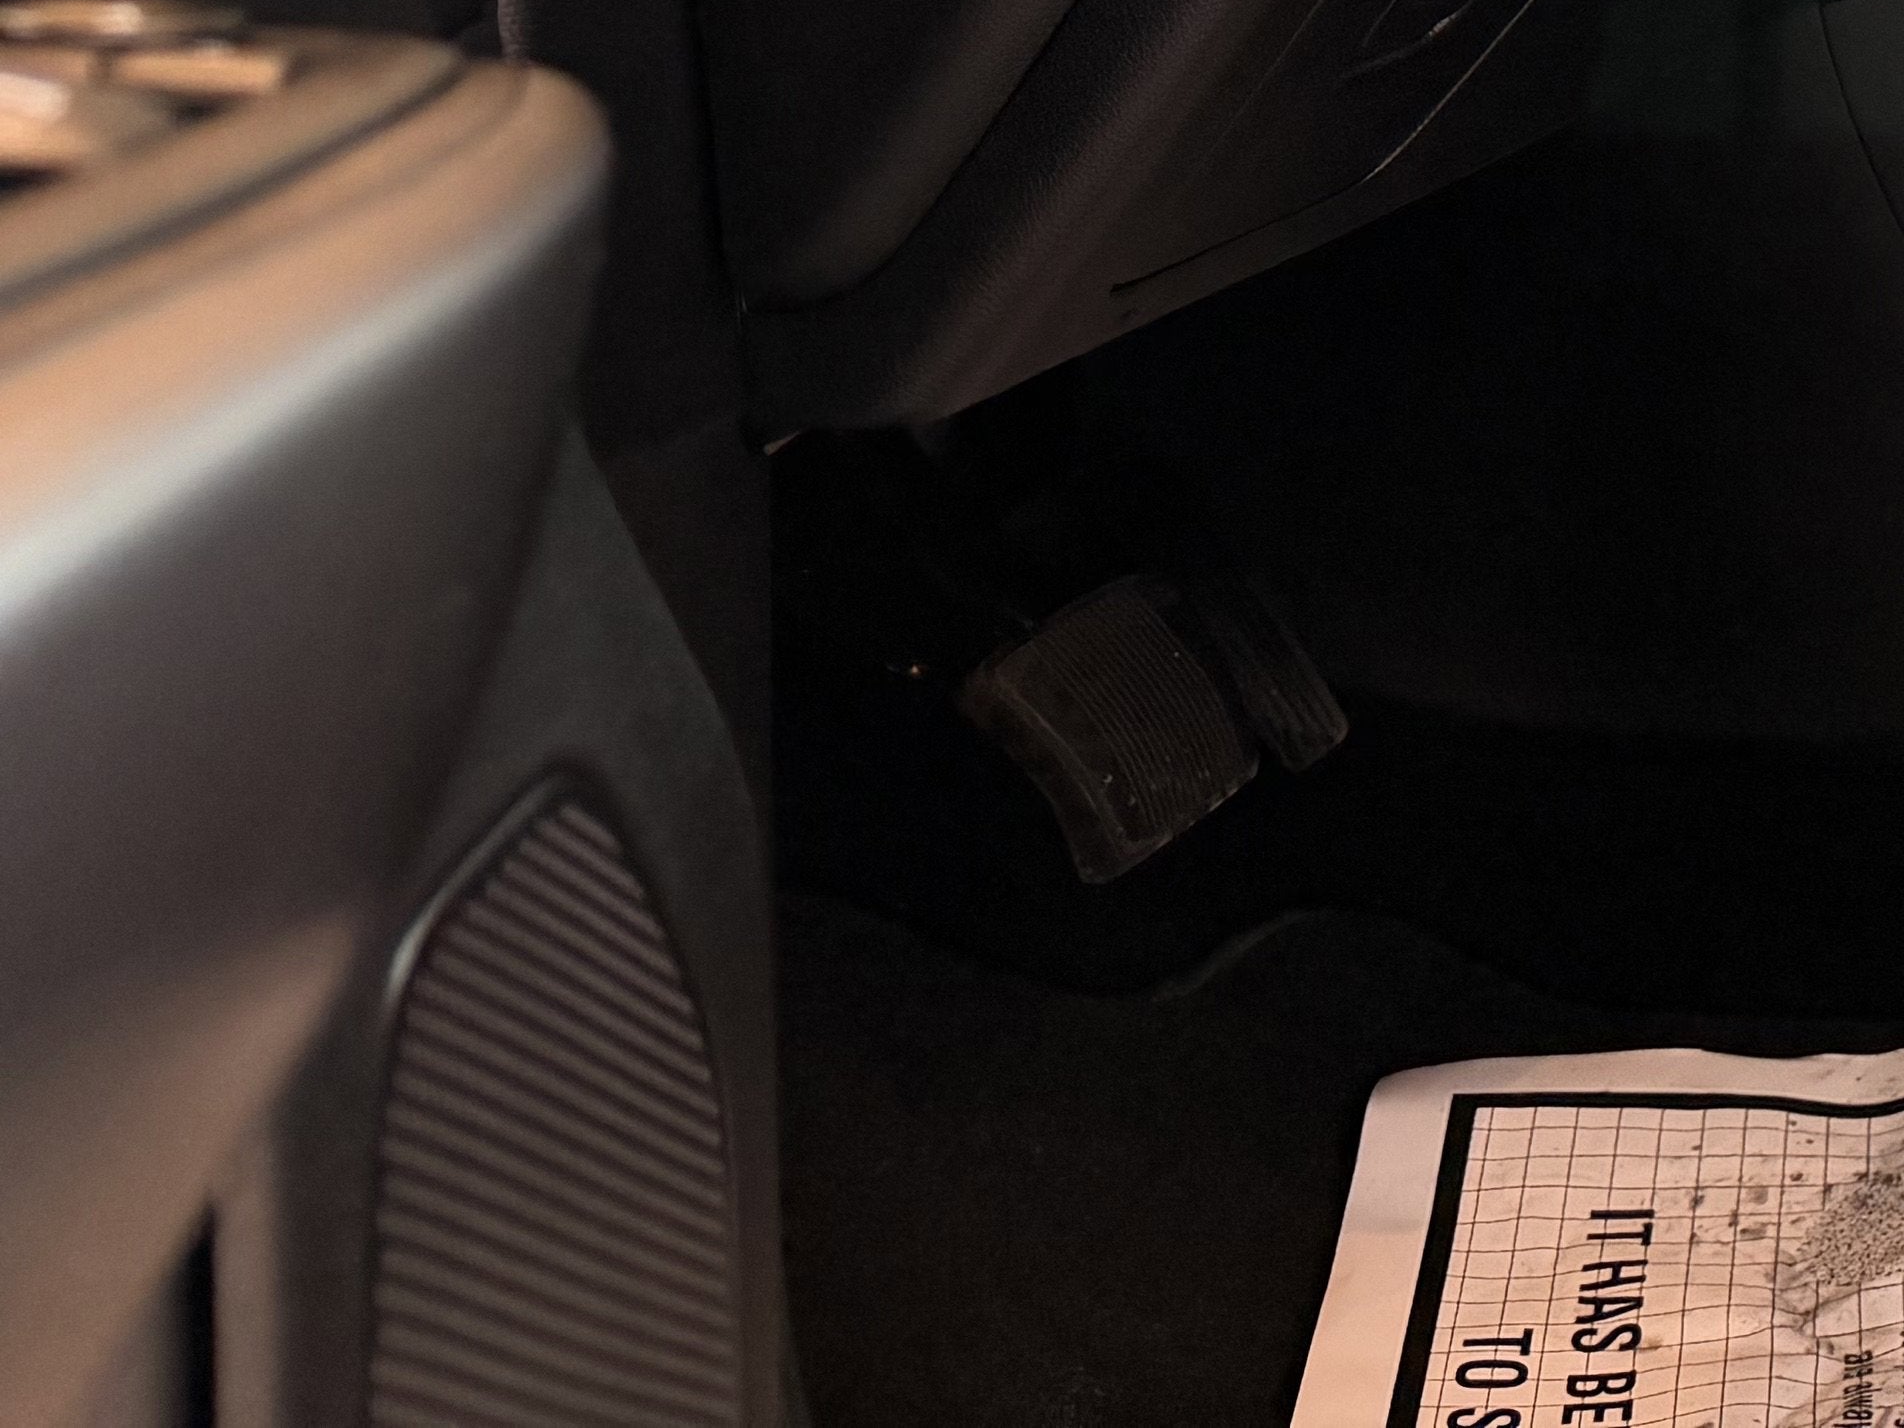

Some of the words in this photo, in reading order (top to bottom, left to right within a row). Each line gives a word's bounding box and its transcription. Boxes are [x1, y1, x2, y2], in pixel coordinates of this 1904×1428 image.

[1586, 1208, 1655, 1246] IT
[1571, 1258, 1649, 1354] HAS
[1455, 1327, 1534, 1389] TO
[1561, 1369, 1637, 1428] BE
